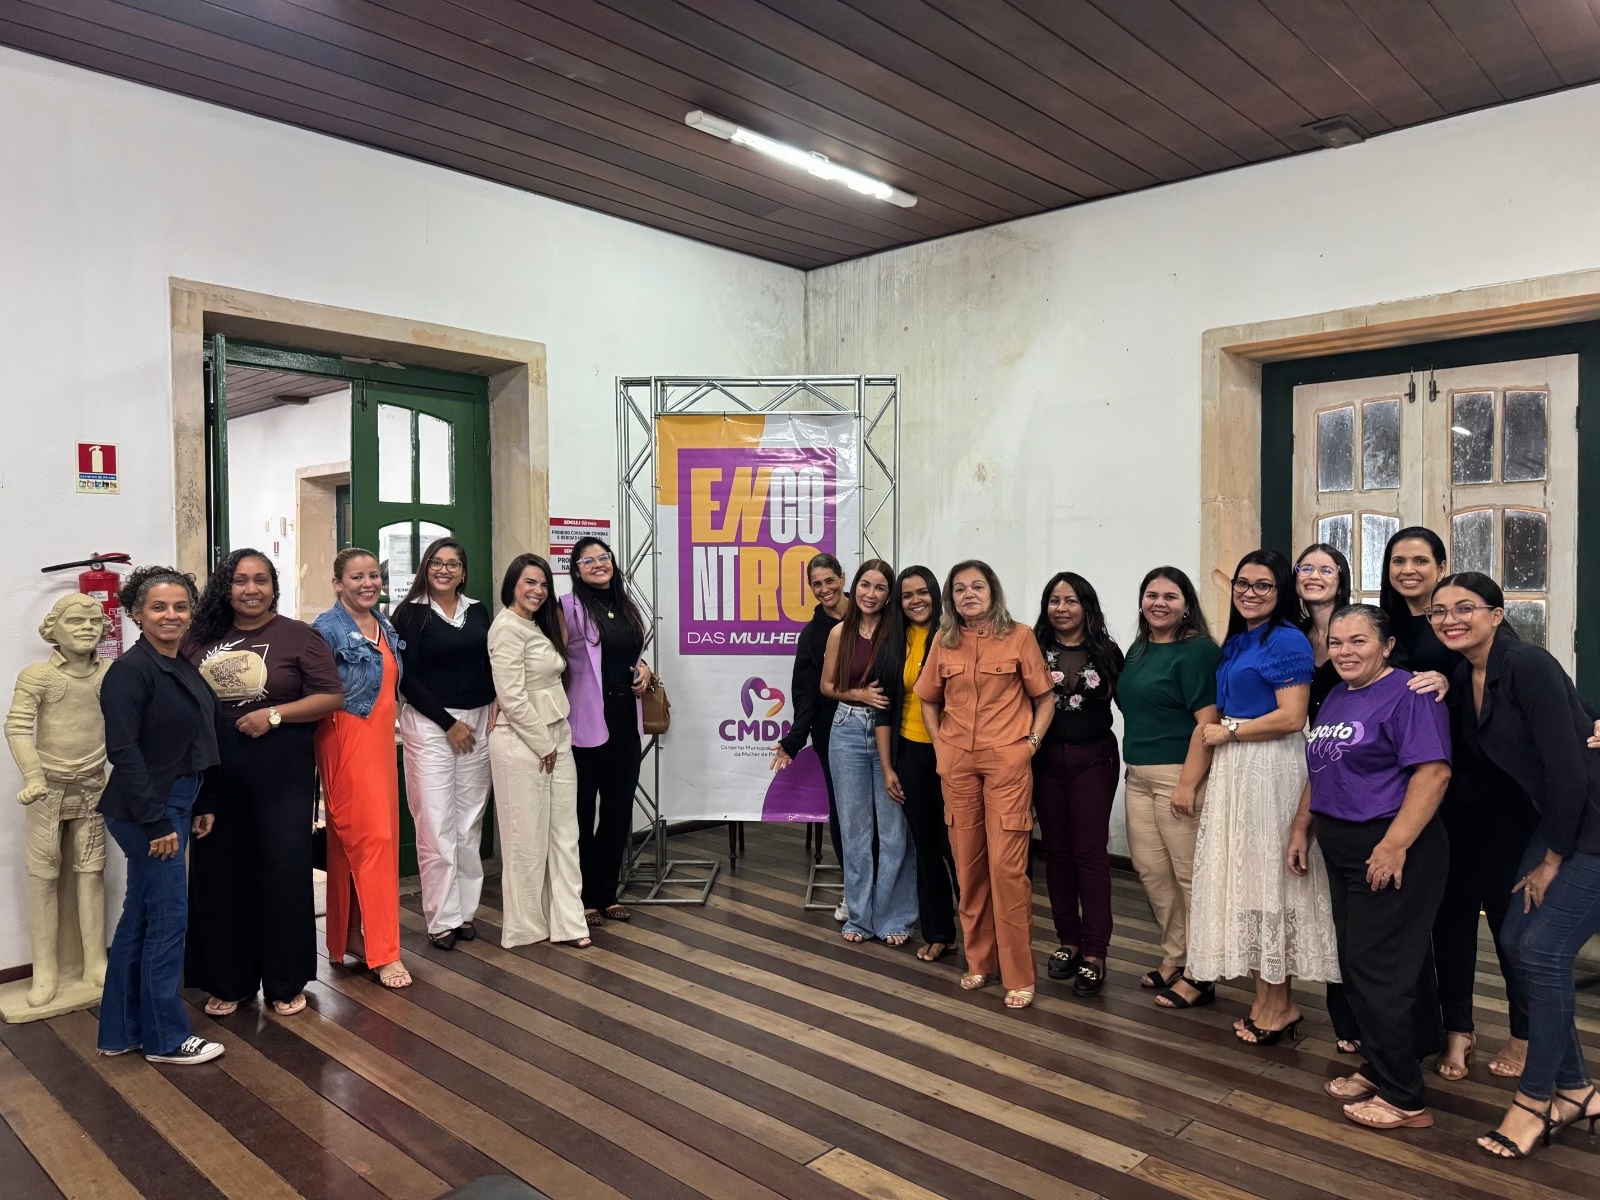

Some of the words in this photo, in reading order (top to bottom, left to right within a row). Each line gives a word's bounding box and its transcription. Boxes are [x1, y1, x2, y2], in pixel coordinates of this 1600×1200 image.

[691, 467, 824, 544] ENCO
[687, 632, 726, 644] DAS
[1308, 722, 1352, 742] gosto
